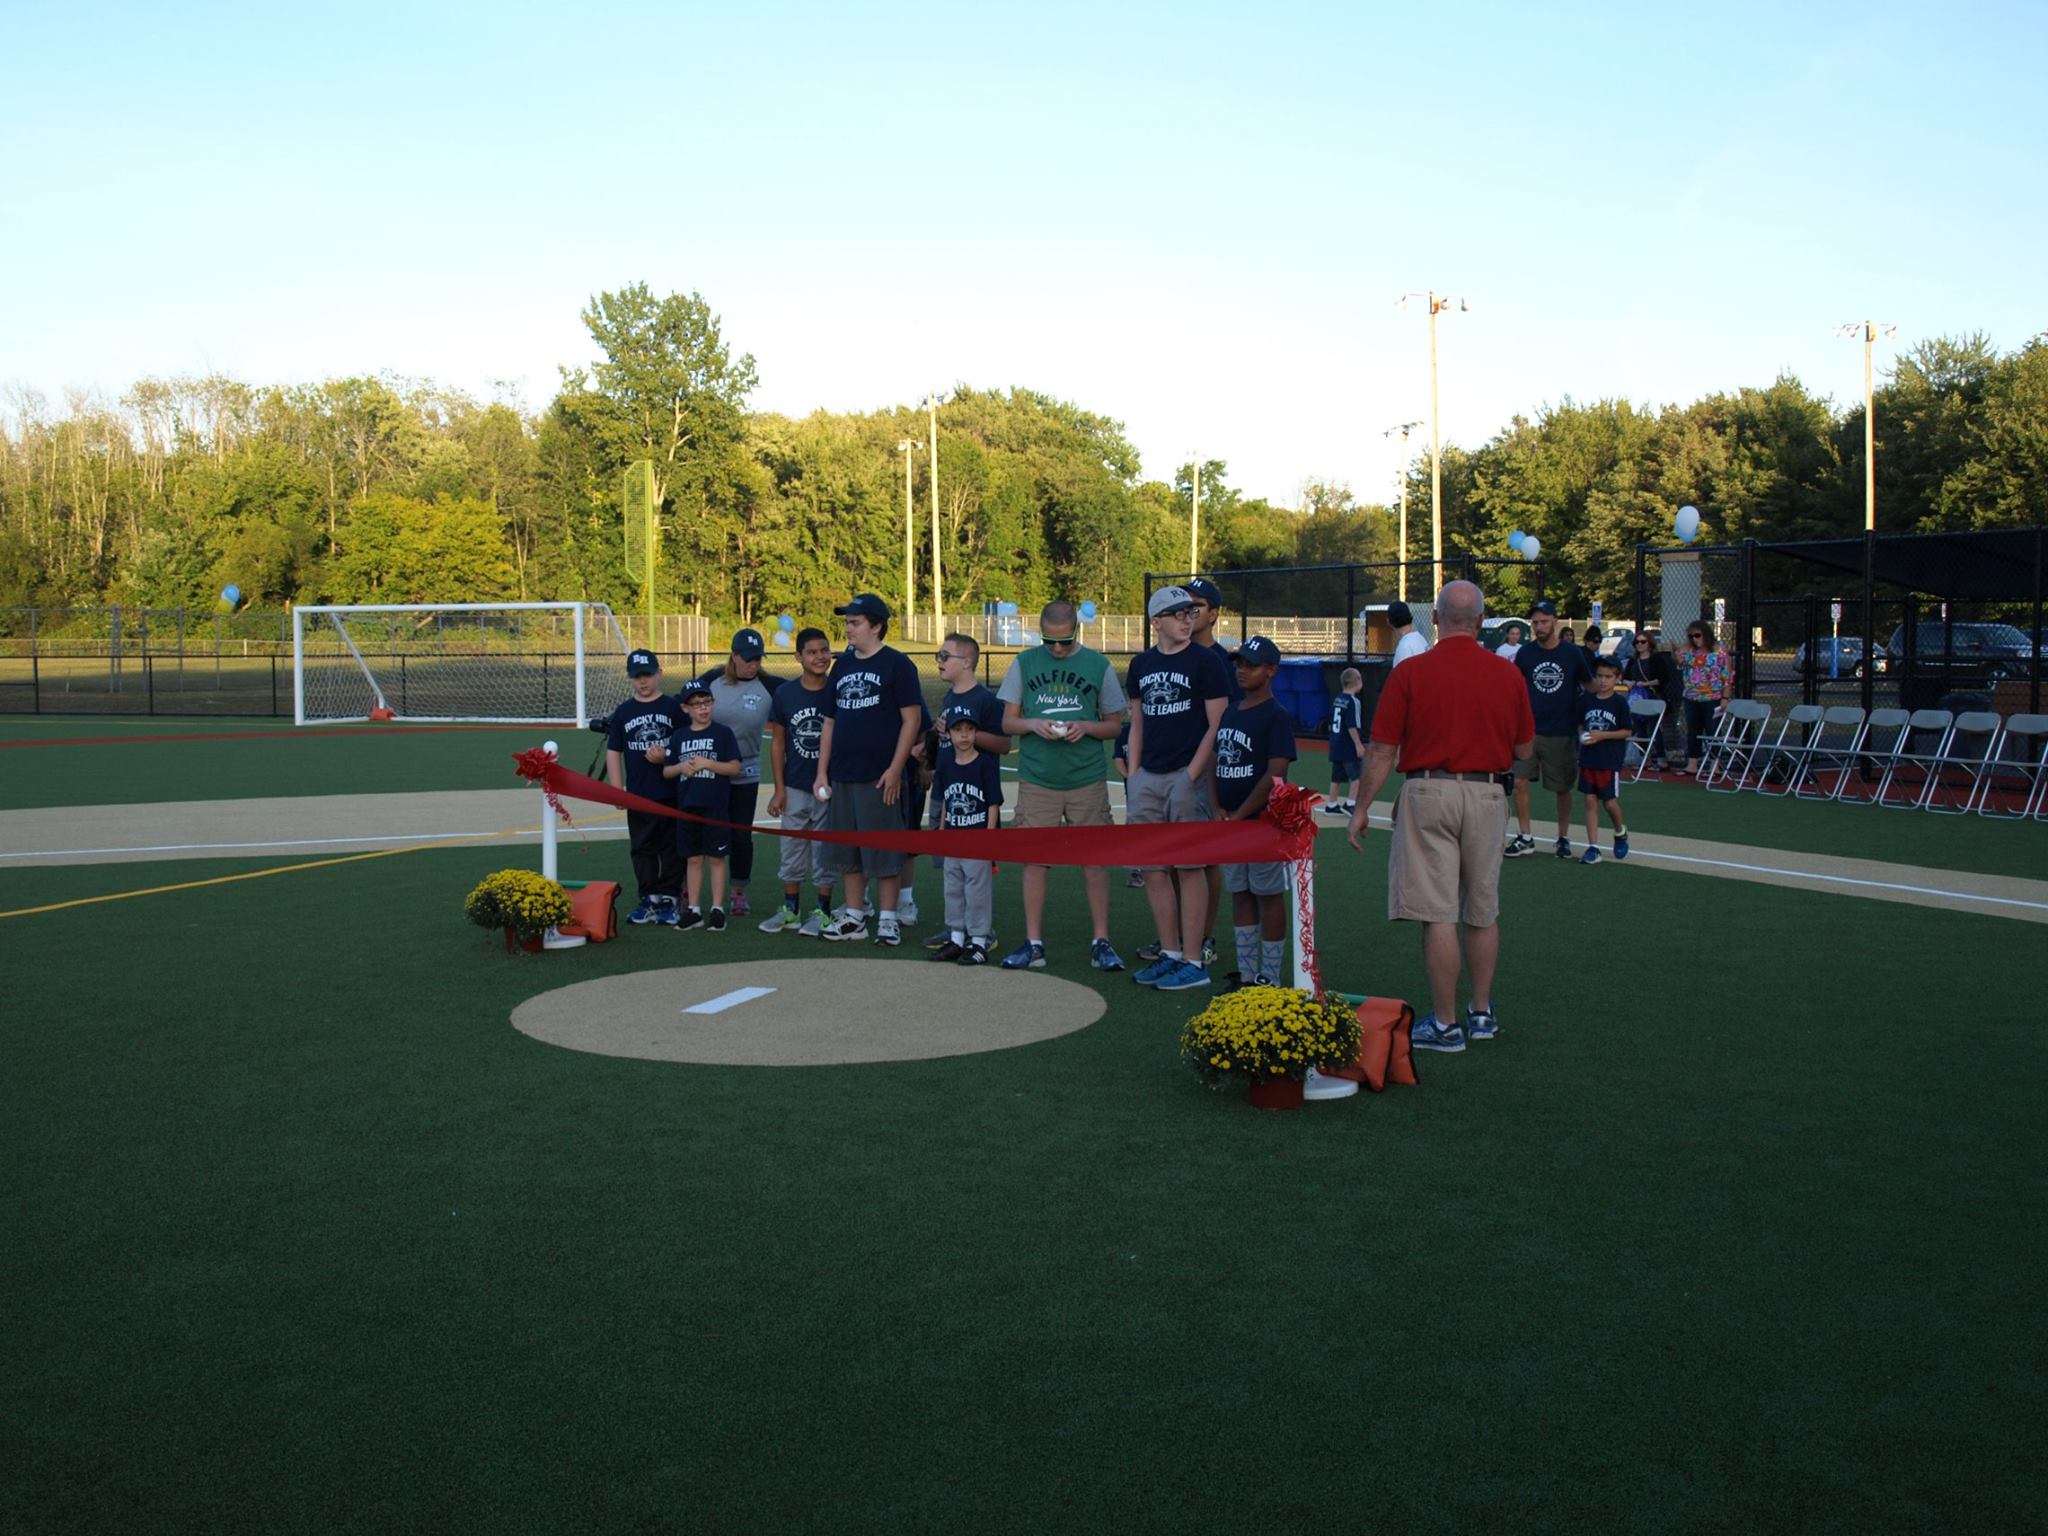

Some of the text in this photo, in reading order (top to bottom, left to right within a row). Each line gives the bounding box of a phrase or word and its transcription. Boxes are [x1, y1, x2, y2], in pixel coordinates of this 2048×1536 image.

[864, 672, 882, 687] HILL
[1027, 669, 1092, 696] HILFIGER
[1169, 671, 1192, 689] HILL
[851, 695, 881, 710] LEAGUE
[1036, 693, 1082, 708] New York
[1157, 699, 1192, 716] LEAGUE
[624, 713, 675, 734] ROCKY HILL
[790, 707, 817, 727] ROCKY
[680, 738, 715, 755] ALONE
[1233, 729, 1253, 752] HILL
[1220, 764, 1254, 779] LEAGUE
[965, 784, 986, 802] HILL
[957, 811, 987, 827] LEAGUE
